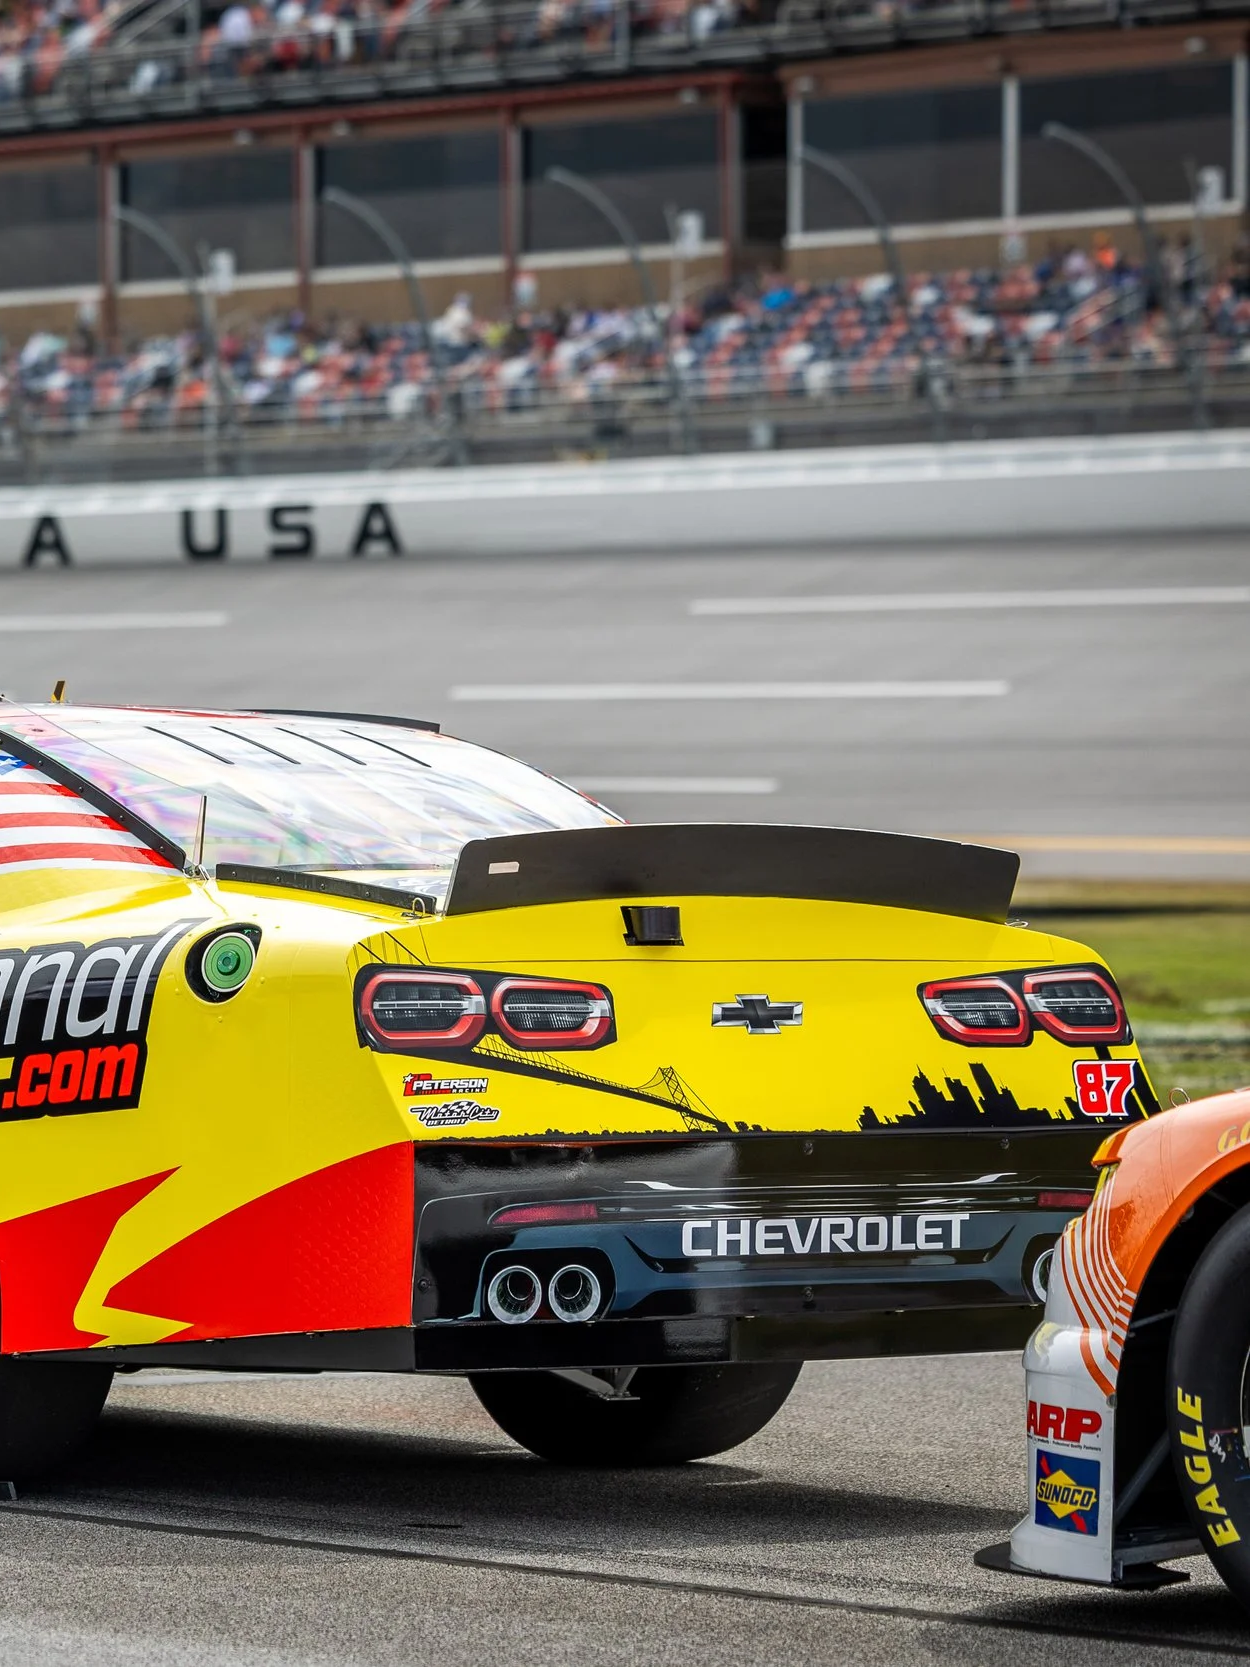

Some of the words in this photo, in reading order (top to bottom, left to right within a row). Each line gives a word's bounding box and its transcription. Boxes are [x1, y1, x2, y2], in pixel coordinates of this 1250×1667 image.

[181, 501, 405, 562] USA
[1, 1042, 140, 1110] .com
[412, 1078, 488, 1091] PETERSON
[1075, 1061, 1134, 1117] 87
[427, 1118, 467, 1126] DETROIT
[469, 1104, 500, 1121] City
[681, 1212, 970, 1257] CHEVROLET
[1026, 1400, 1103, 1443] ARP
[1176, 1386, 1242, 1548] EAGLE
[1038, 1481, 1096, 1508] SUNOCO
